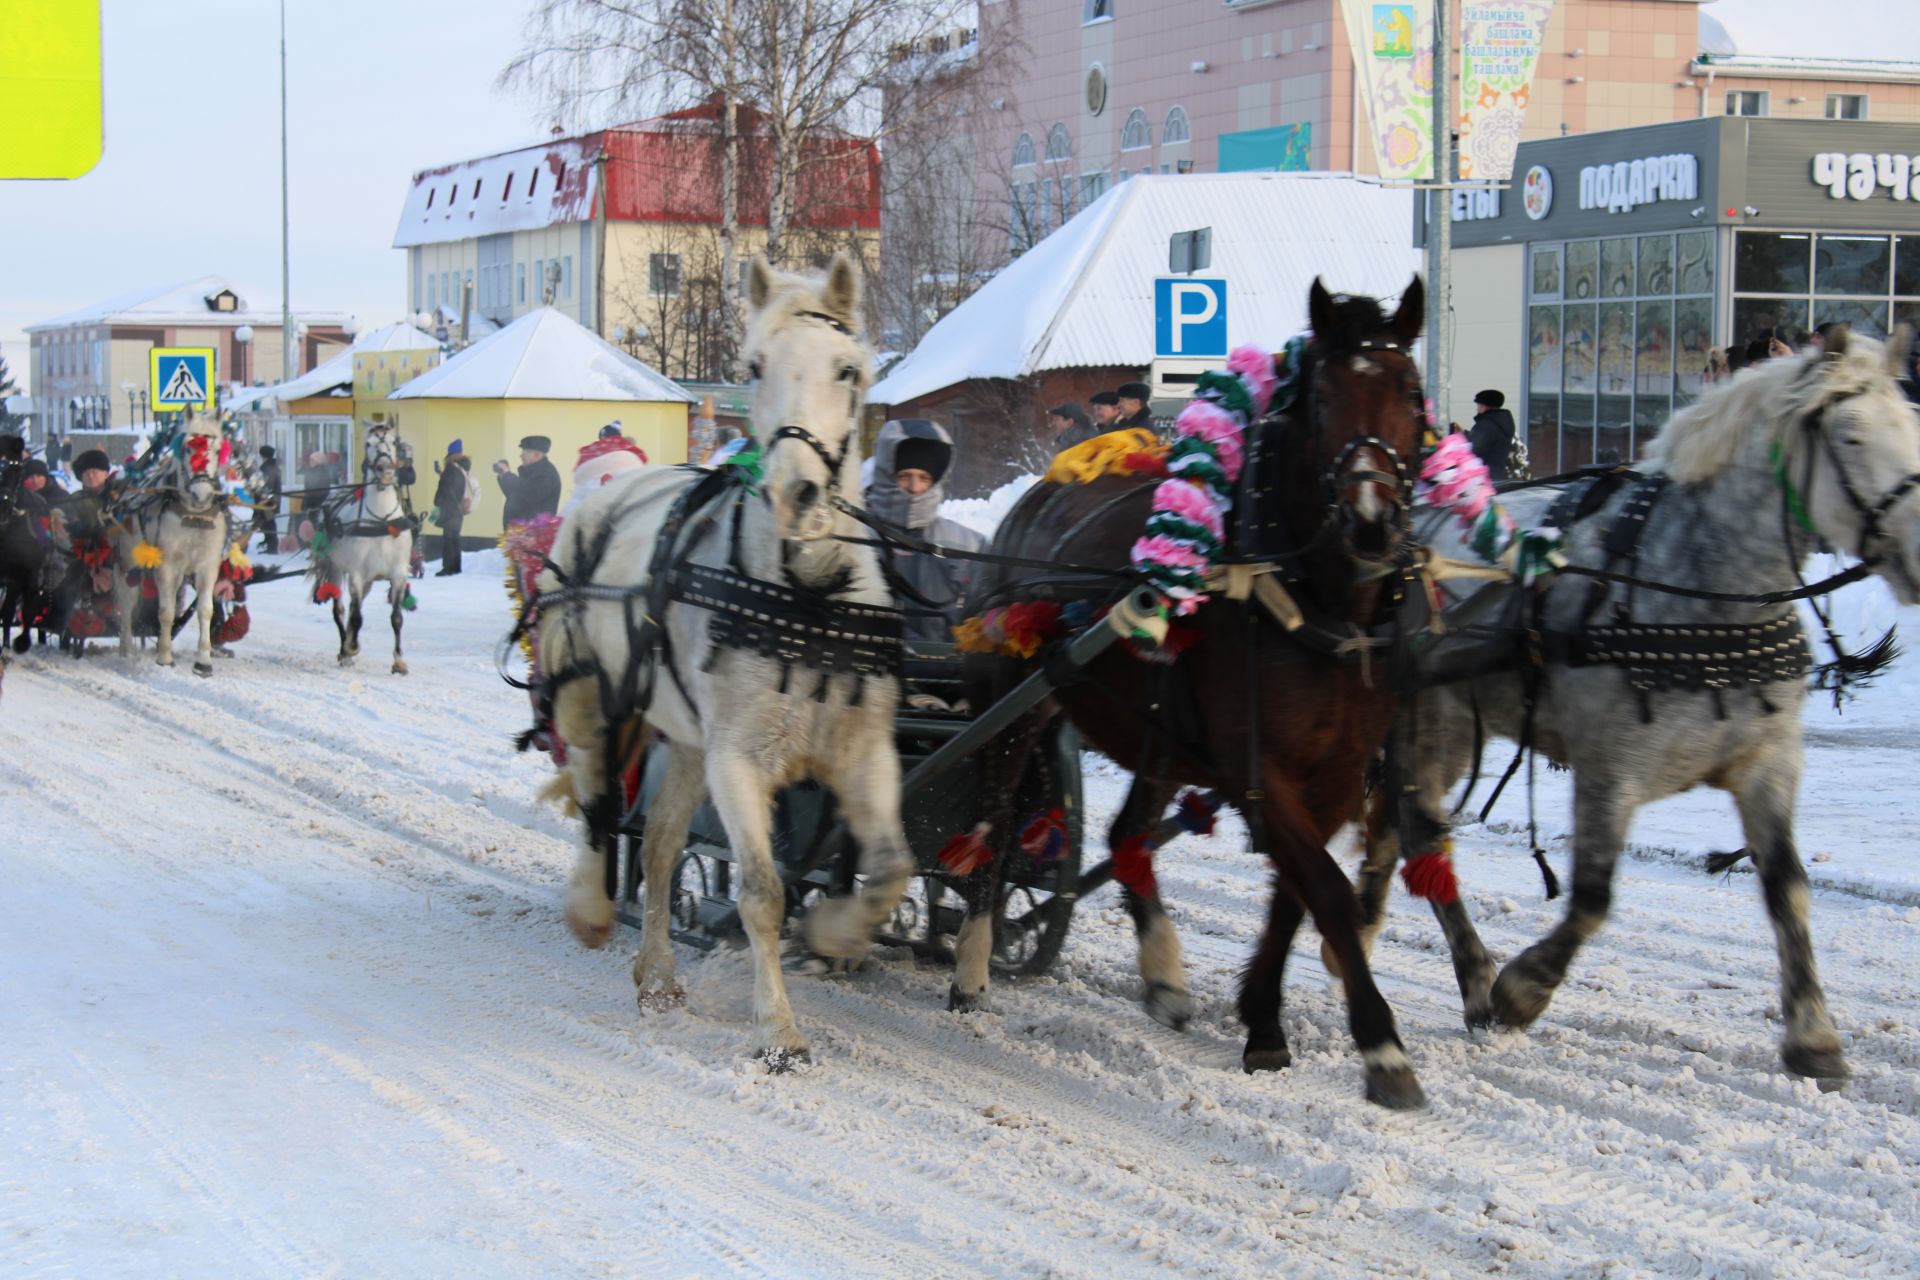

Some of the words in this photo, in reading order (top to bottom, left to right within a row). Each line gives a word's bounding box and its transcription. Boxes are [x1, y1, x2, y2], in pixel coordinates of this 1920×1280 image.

[1425, 180, 1500, 224] ЕТЫ
[1579, 153, 1699, 214] ПОДАРКИ
[1171, 283, 1218, 353] P
